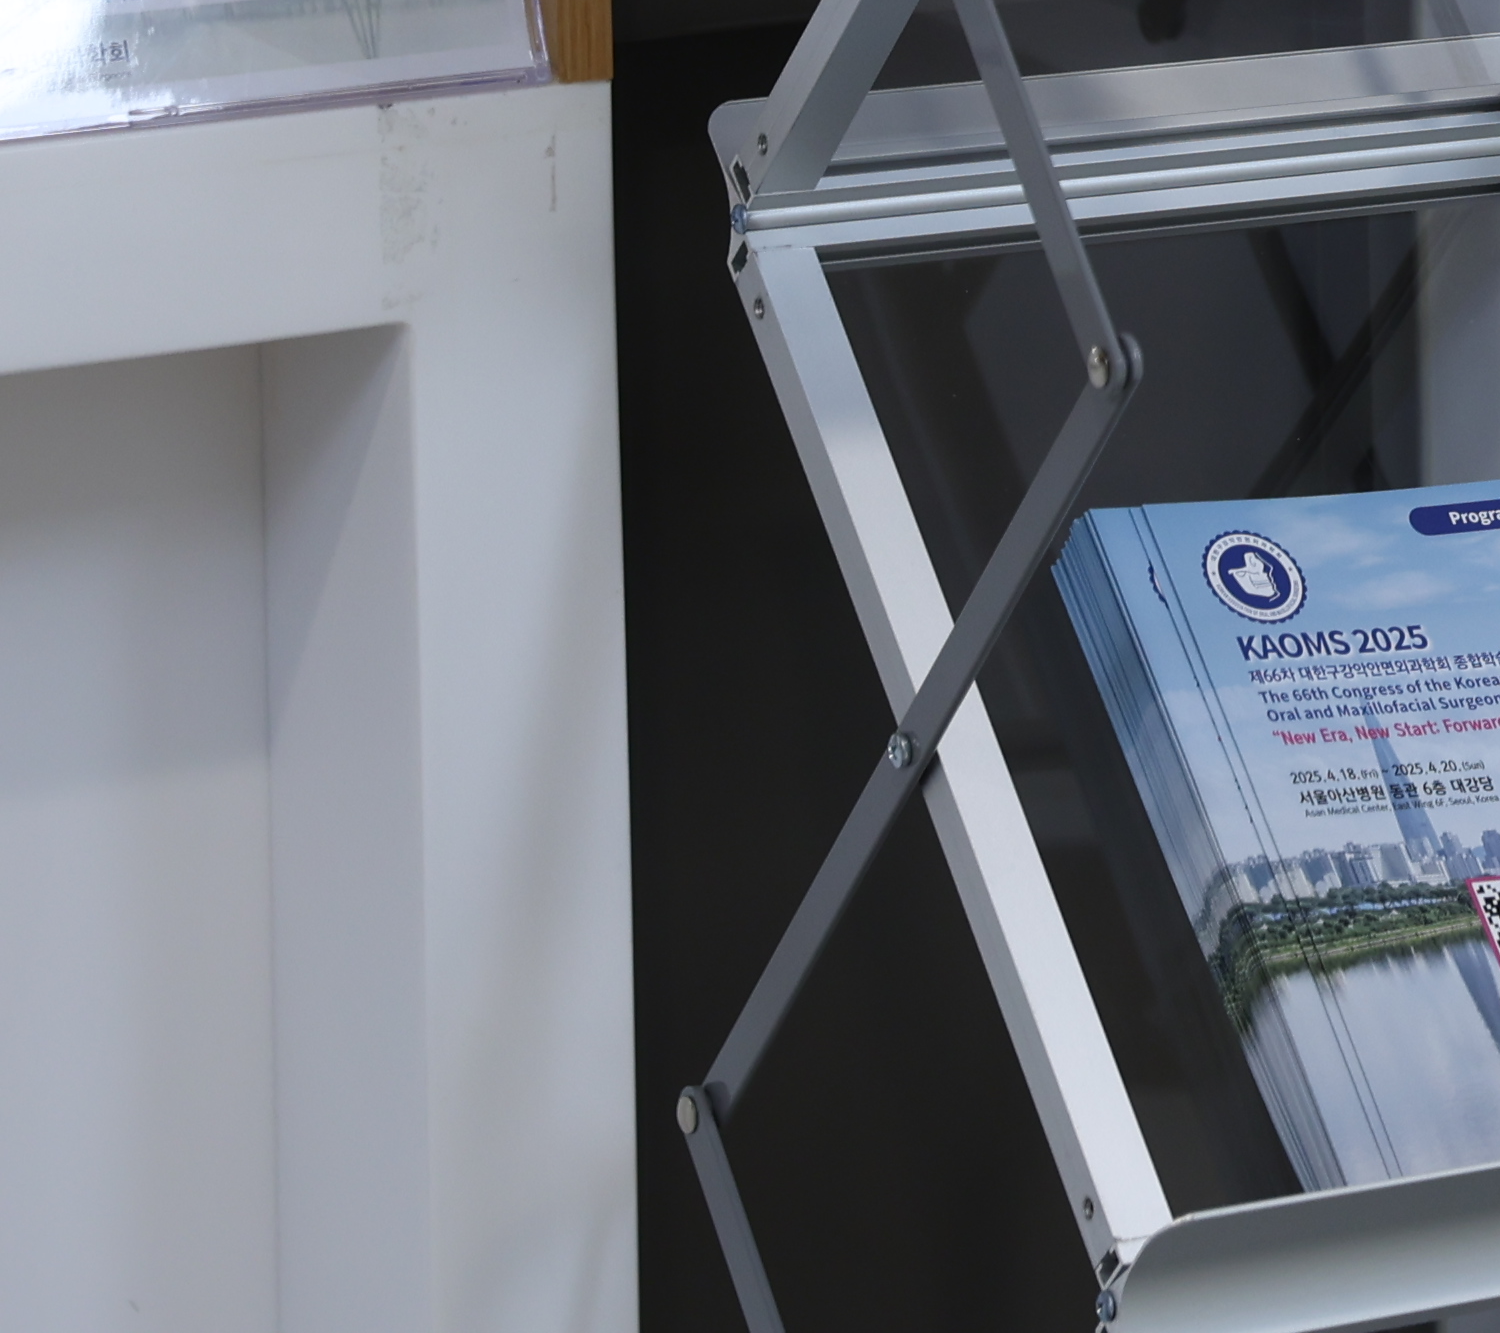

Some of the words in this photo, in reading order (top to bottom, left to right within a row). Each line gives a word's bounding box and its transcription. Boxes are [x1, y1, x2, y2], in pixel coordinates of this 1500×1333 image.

[1236, 630, 1351, 661] KAOMS
[1352, 624, 1429, 654] 2025
[1249, 666, 1296, 684] 제66차
[1299, 656, 1452, 682] 대한구강악안면외과학회
[1259, 690, 1290, 704] The
[1292, 685, 1329, 702] 66th
[1331, 682, 1404, 701] Congress
[1406, 679, 1423, 694] of
[1424, 677, 1452, 692] the
[1266, 706, 1302, 722] Oral
[1305, 704, 1334, 720] and
[1338, 697, 1436, 718] Maxillofacial
[1272, 729, 1316, 746] “New
[1319, 727, 1353, 744] Era,
[1355, 724, 1390, 740] New
[1393, 720, 1440, 738] Start:
[1289, 768, 1379, 784] 2025.4.18.(Fri)
[1392, 759, 1485, 777] 2025.4.20.(Sun)
[1299, 784, 1387, 806] 서울아산병원
[1389, 782, 1419, 800] 동관
[1423, 779, 1447, 796] 6층
[1450, 776, 1495, 794] 대강당
[1327, 804, 1360, 816] Medical
[1475, 794, 1500, 804] Korea
